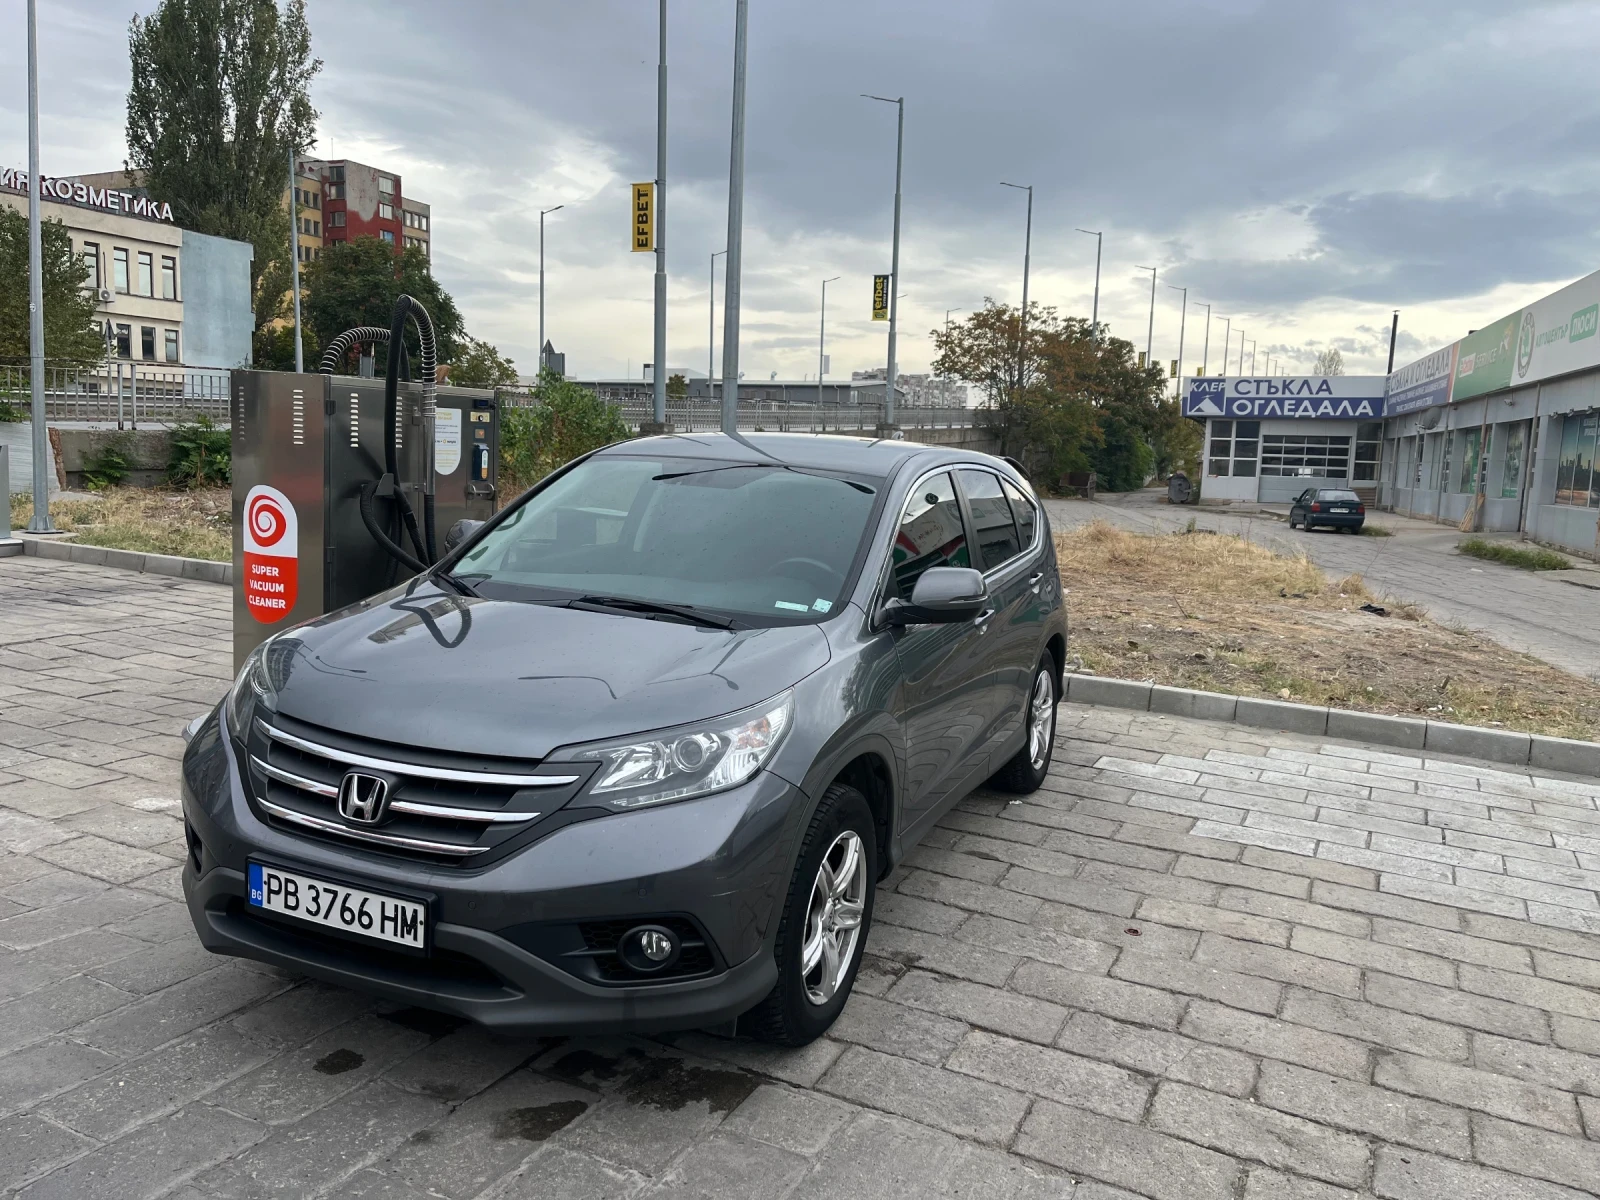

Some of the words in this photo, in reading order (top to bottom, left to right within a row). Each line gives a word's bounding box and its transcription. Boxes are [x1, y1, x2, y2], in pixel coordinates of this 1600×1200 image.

[41, 177, 174, 222] КОЗМЕТИКА
[637, 188, 648, 247] EFBET
[875, 277, 883, 309] efbet
[1571, 310, 1596, 337] ЛЮСИ
[1415, 349, 1450, 383] ОГЛЕДАЛА
[1190, 382, 1225, 392] КЛЕР
[1234, 379, 1333, 395] СТЪКЛА
[1232, 399, 1374, 418] ОГЛЕДАЛА
[251, 563, 280, 577] SUPER
[249, 579, 285, 593] VACUUM
[248, 594, 286, 609] CLEANER
[251, 888, 262, 901] BG
[266, 872, 301, 912] PB
[305, 884, 374, 931] 3766
[380, 900, 418, 943] HM
